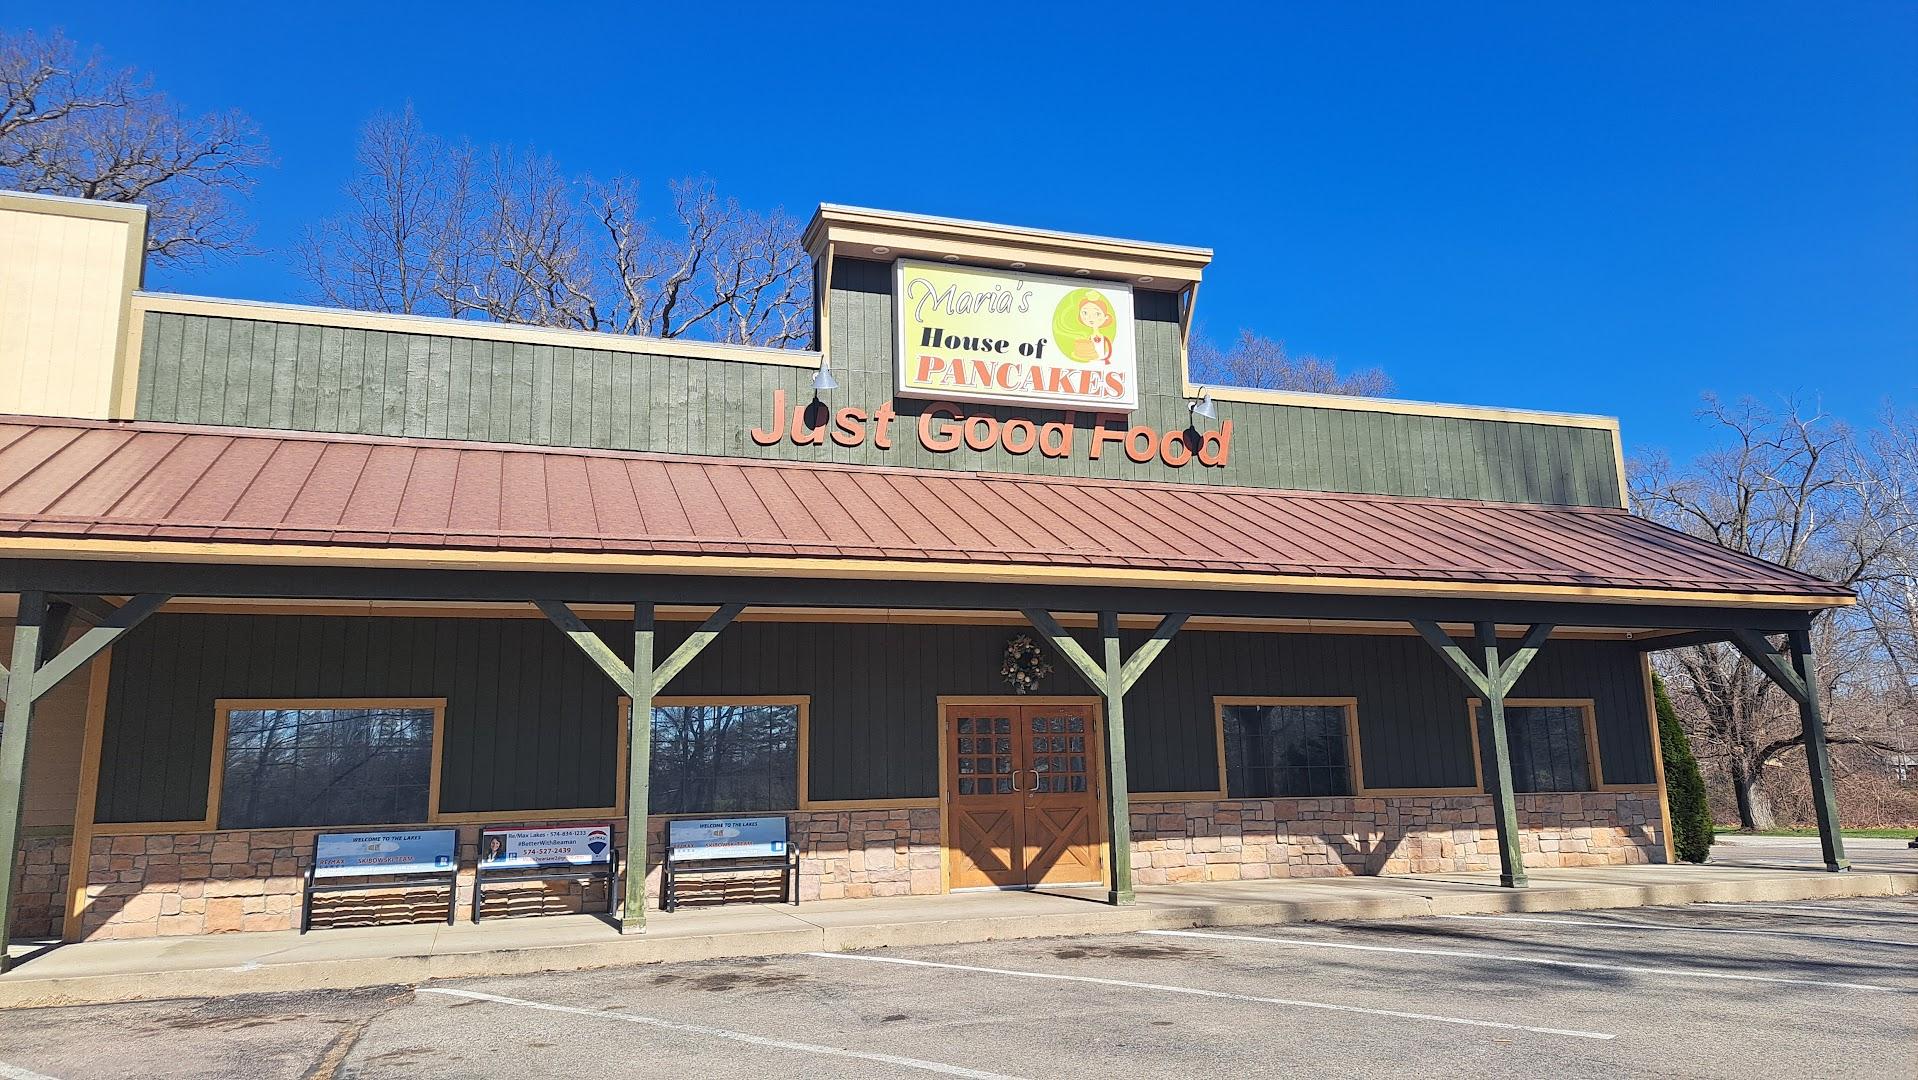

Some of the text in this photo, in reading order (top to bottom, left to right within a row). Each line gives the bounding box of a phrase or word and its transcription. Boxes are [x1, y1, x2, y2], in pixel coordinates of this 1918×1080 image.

[907, 278, 1033, 323] Maria's
[921, 327, 1048, 358] House of
[915, 356, 1126, 400] PANCAKES
[751, 389, 1234, 467] Just Good Food
[518, 839, 577, 847] #BetterWithBeaman
